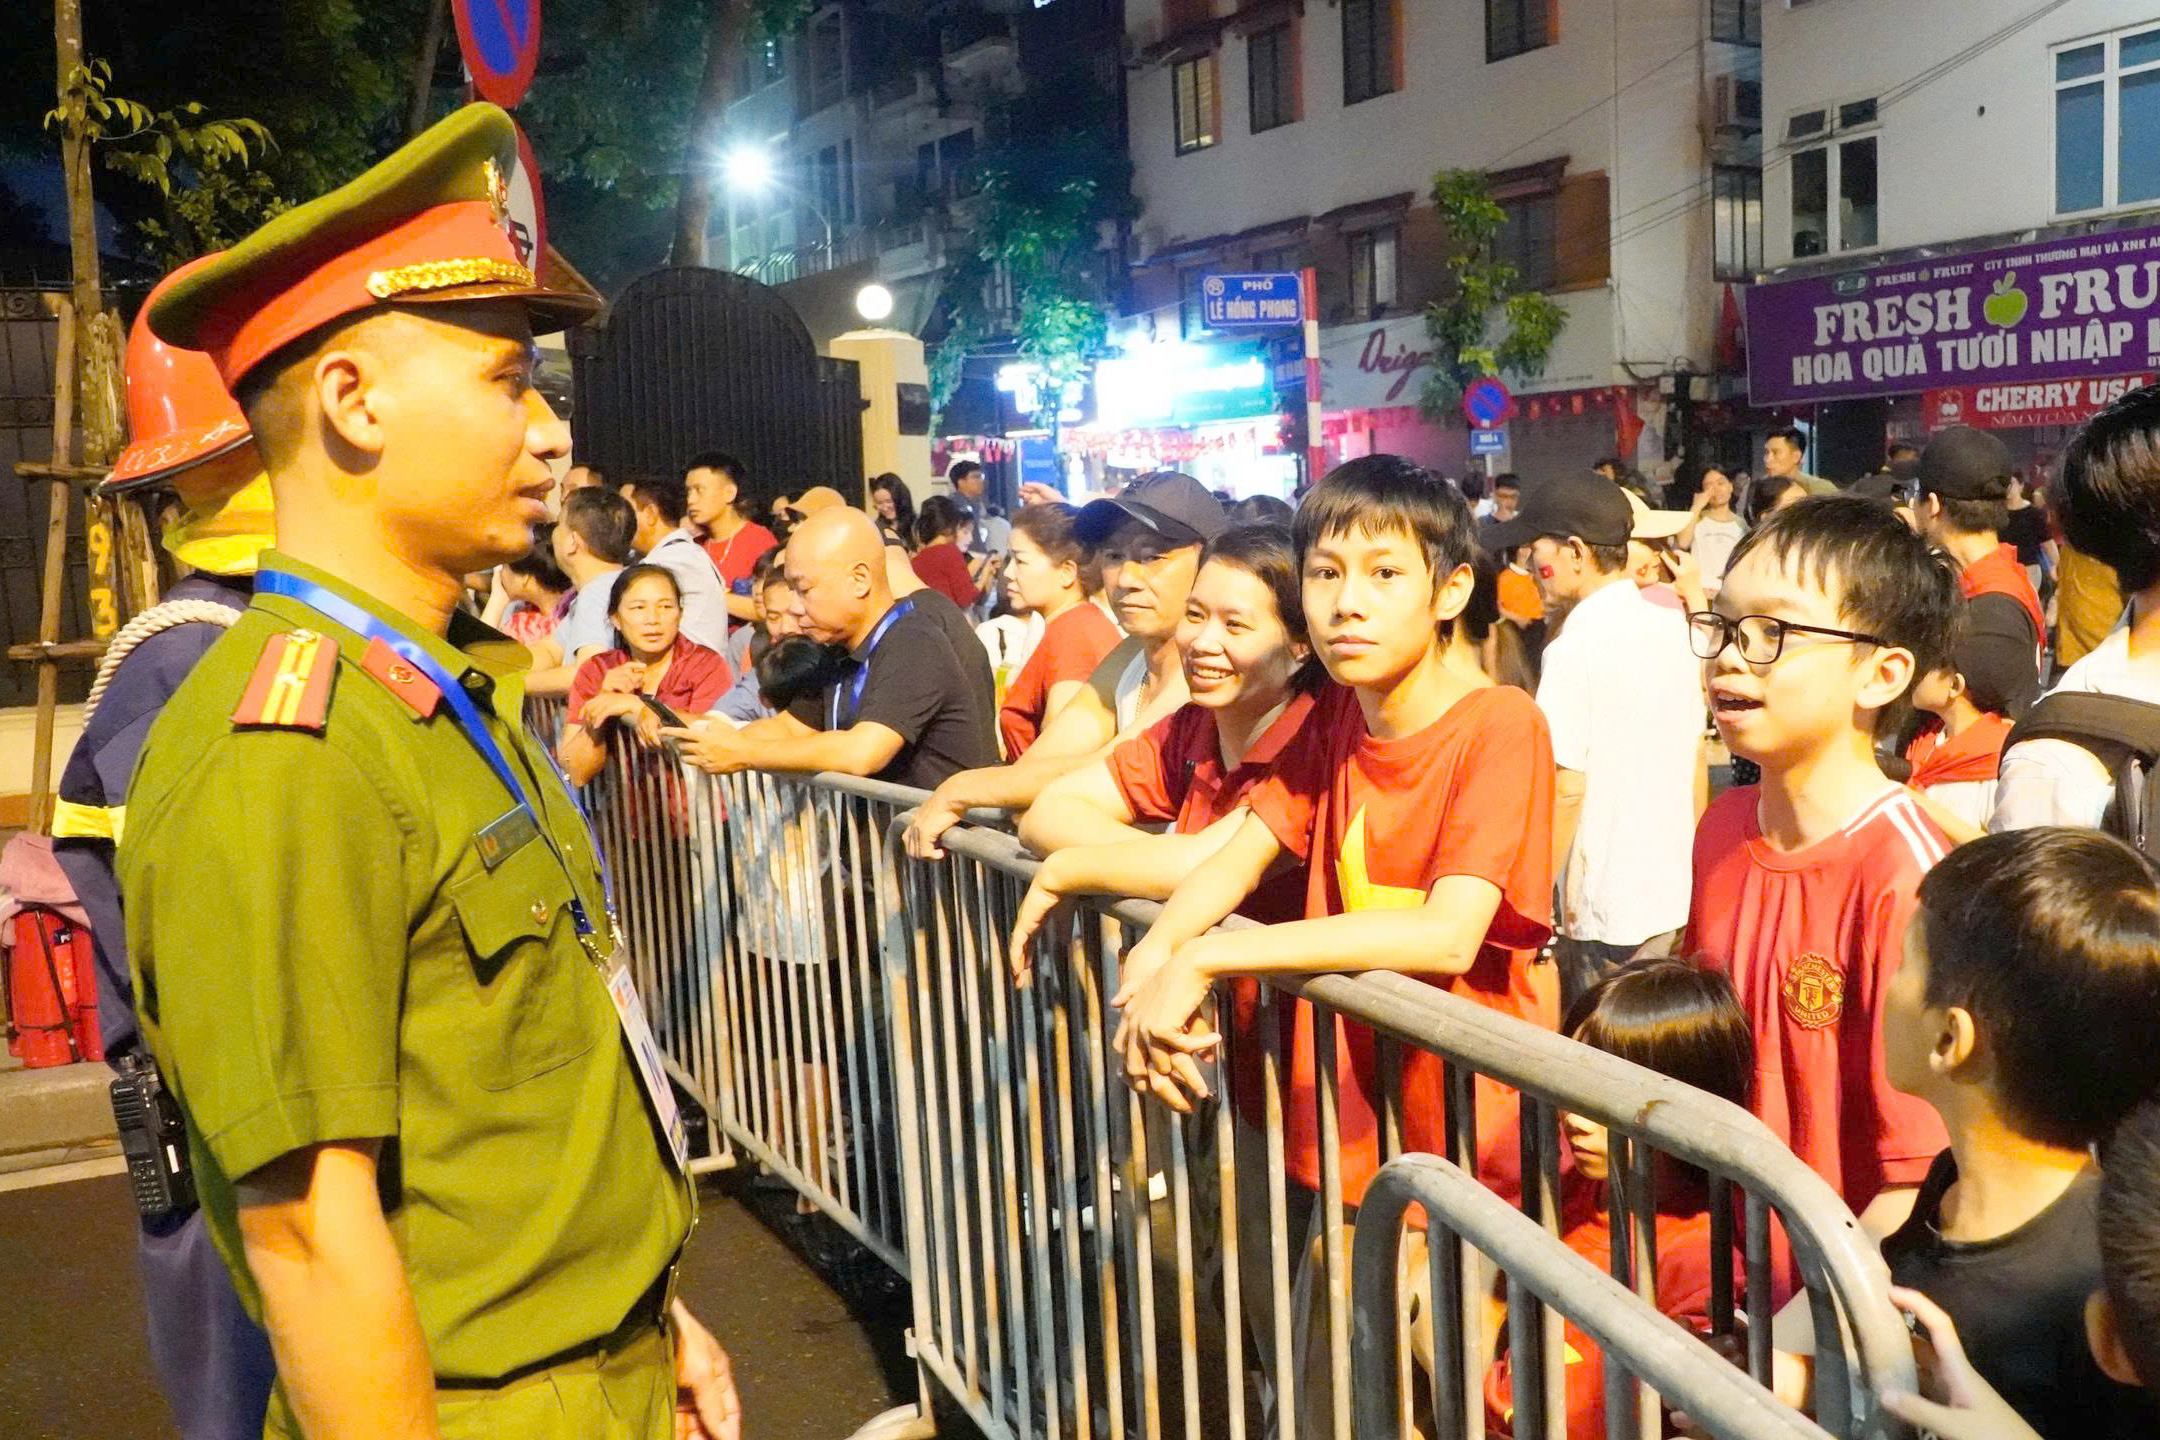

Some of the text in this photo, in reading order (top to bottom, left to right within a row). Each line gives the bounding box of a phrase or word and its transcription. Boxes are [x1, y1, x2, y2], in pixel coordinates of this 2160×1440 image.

[1876, 272, 1916, 287] FRESH
[1933, 264, 1974, 279] FRUIT
[1259, 298, 1297, 319] PHONG
[1813, 286, 1972, 347] FRESH
[1792, 351, 1853, 386] HOA
[1862, 335, 1928, 382] QUẢ
[1936, 328, 2018, 372] TƯƠI
[2030, 318, 2134, 365] NHẬP
[1976, 380, 2082, 413] CHERRY
